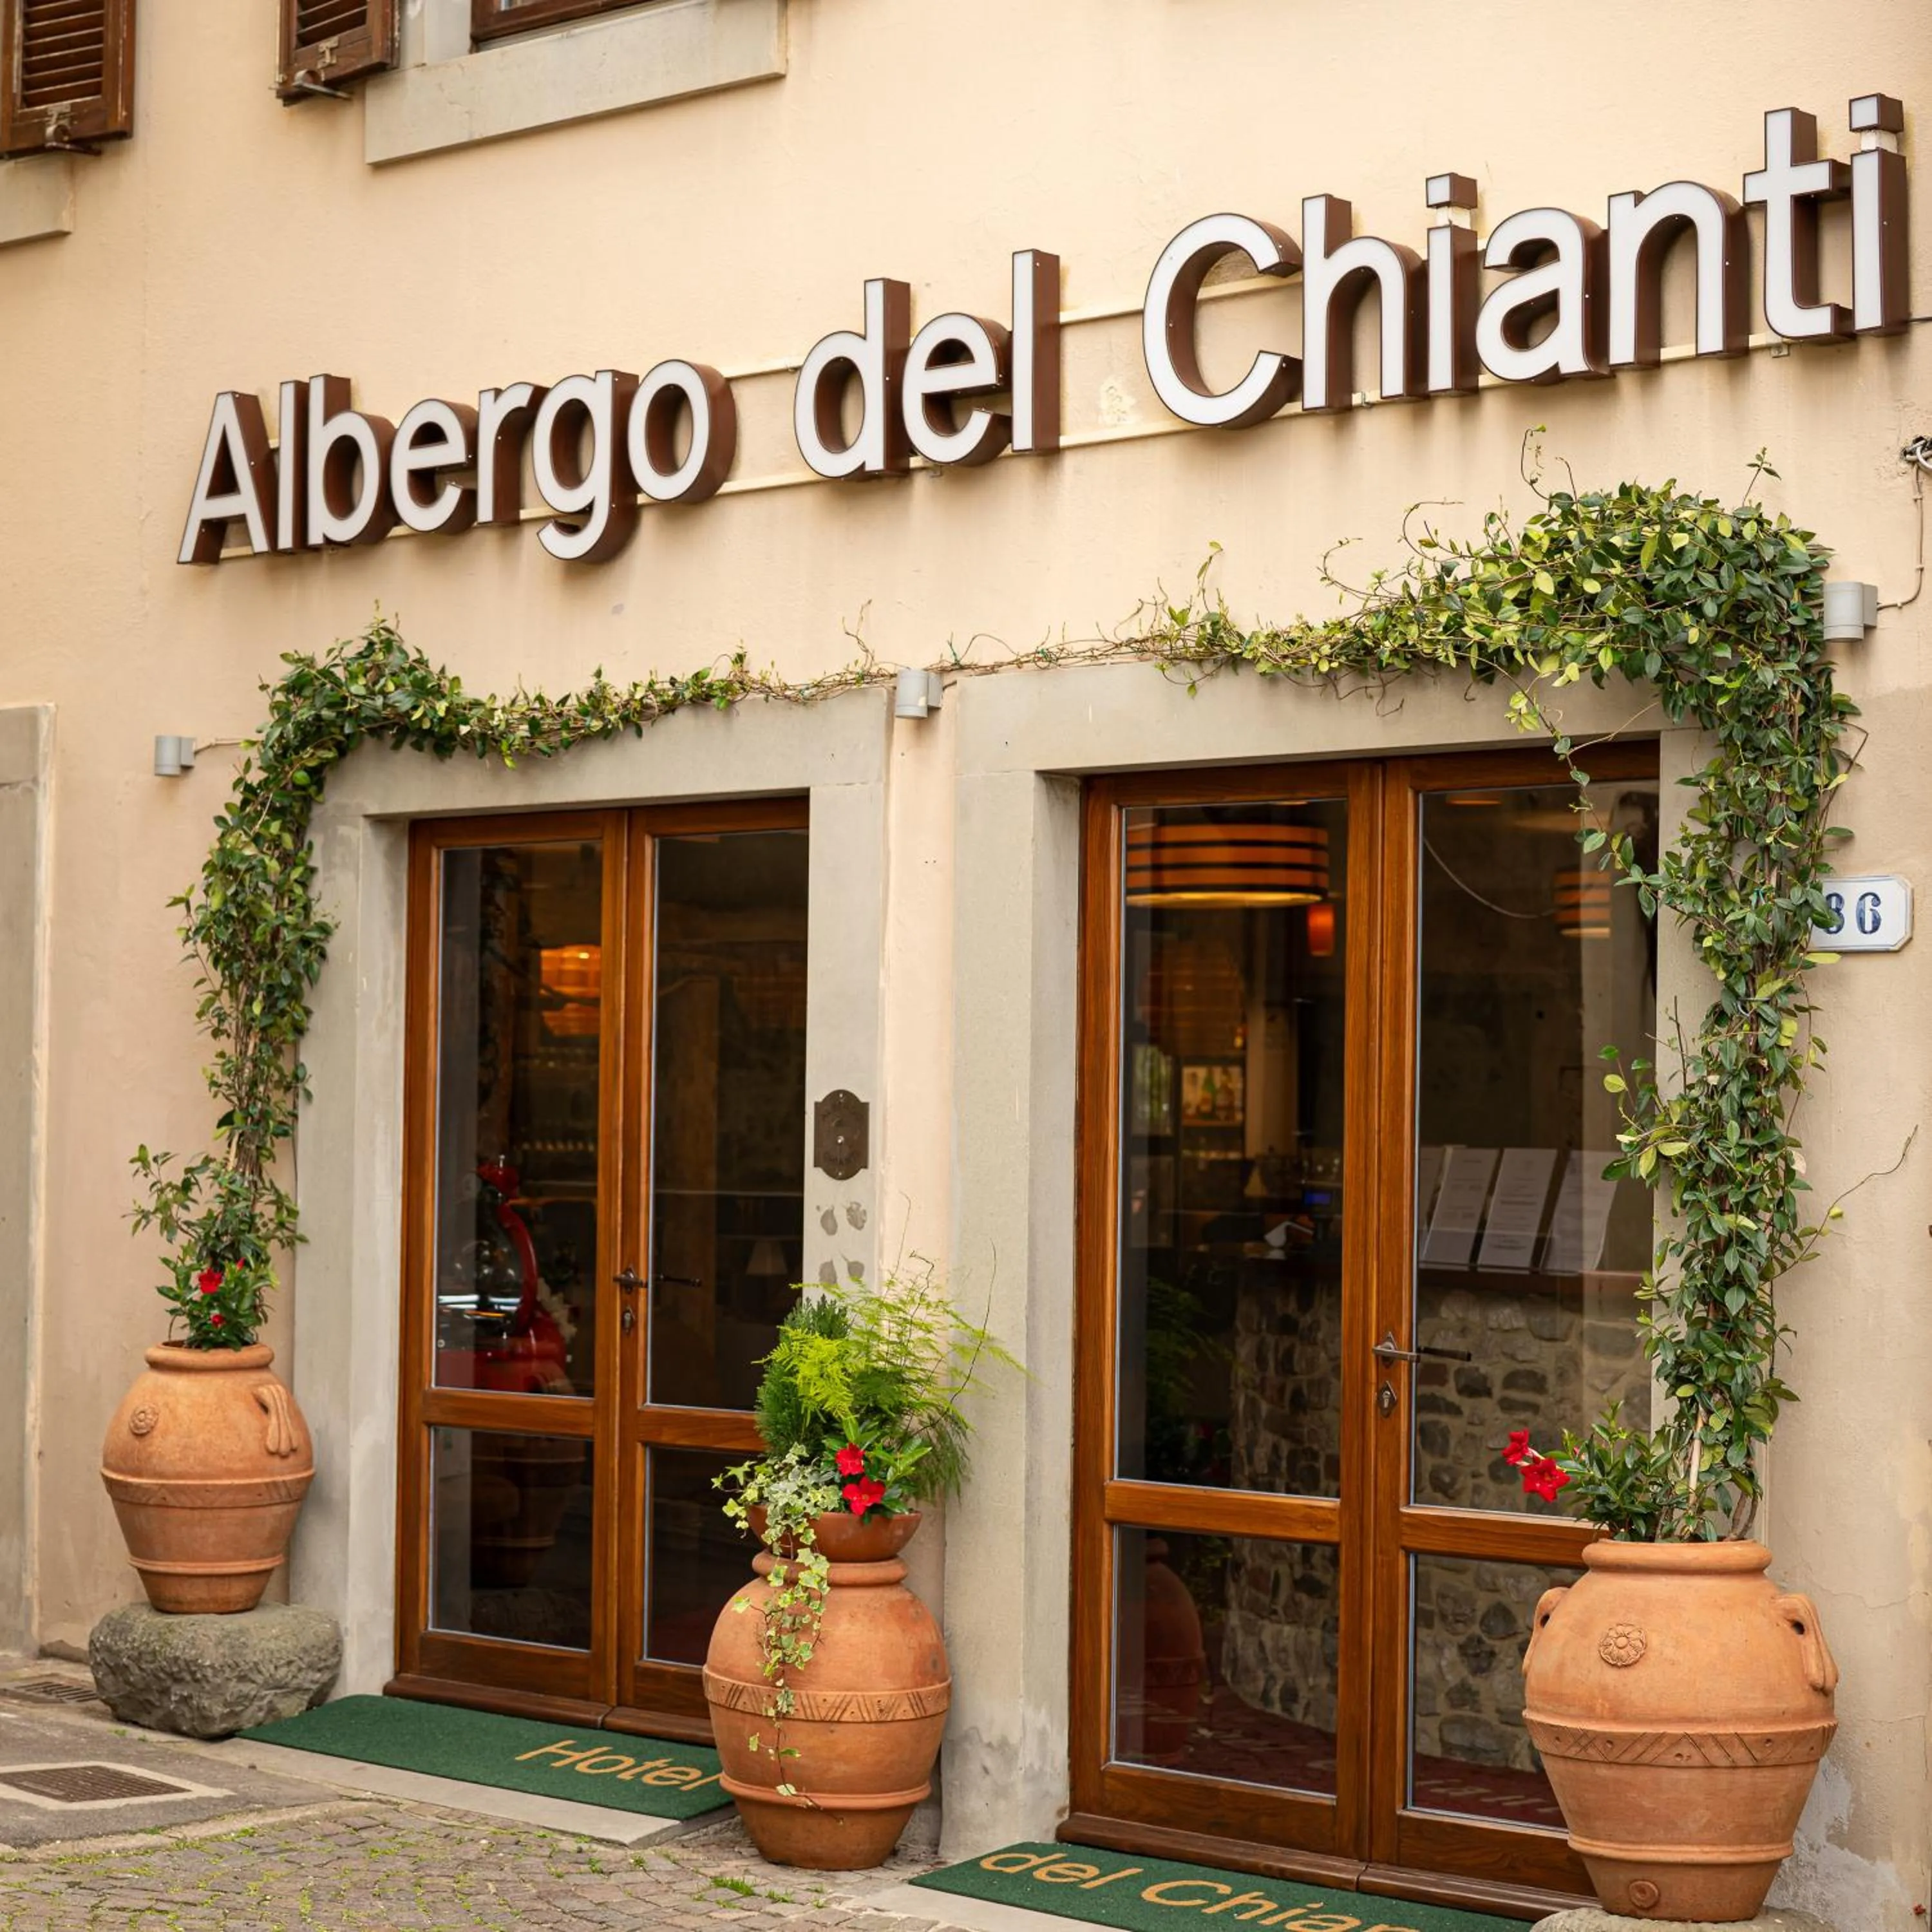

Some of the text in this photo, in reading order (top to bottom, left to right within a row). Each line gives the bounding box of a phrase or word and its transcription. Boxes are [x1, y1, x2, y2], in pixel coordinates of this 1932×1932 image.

[176, 93, 1907, 564] Albergo del Chianti
[515, 1739, 723, 1792] Hotel
[980, 1852, 1144, 1889] del
